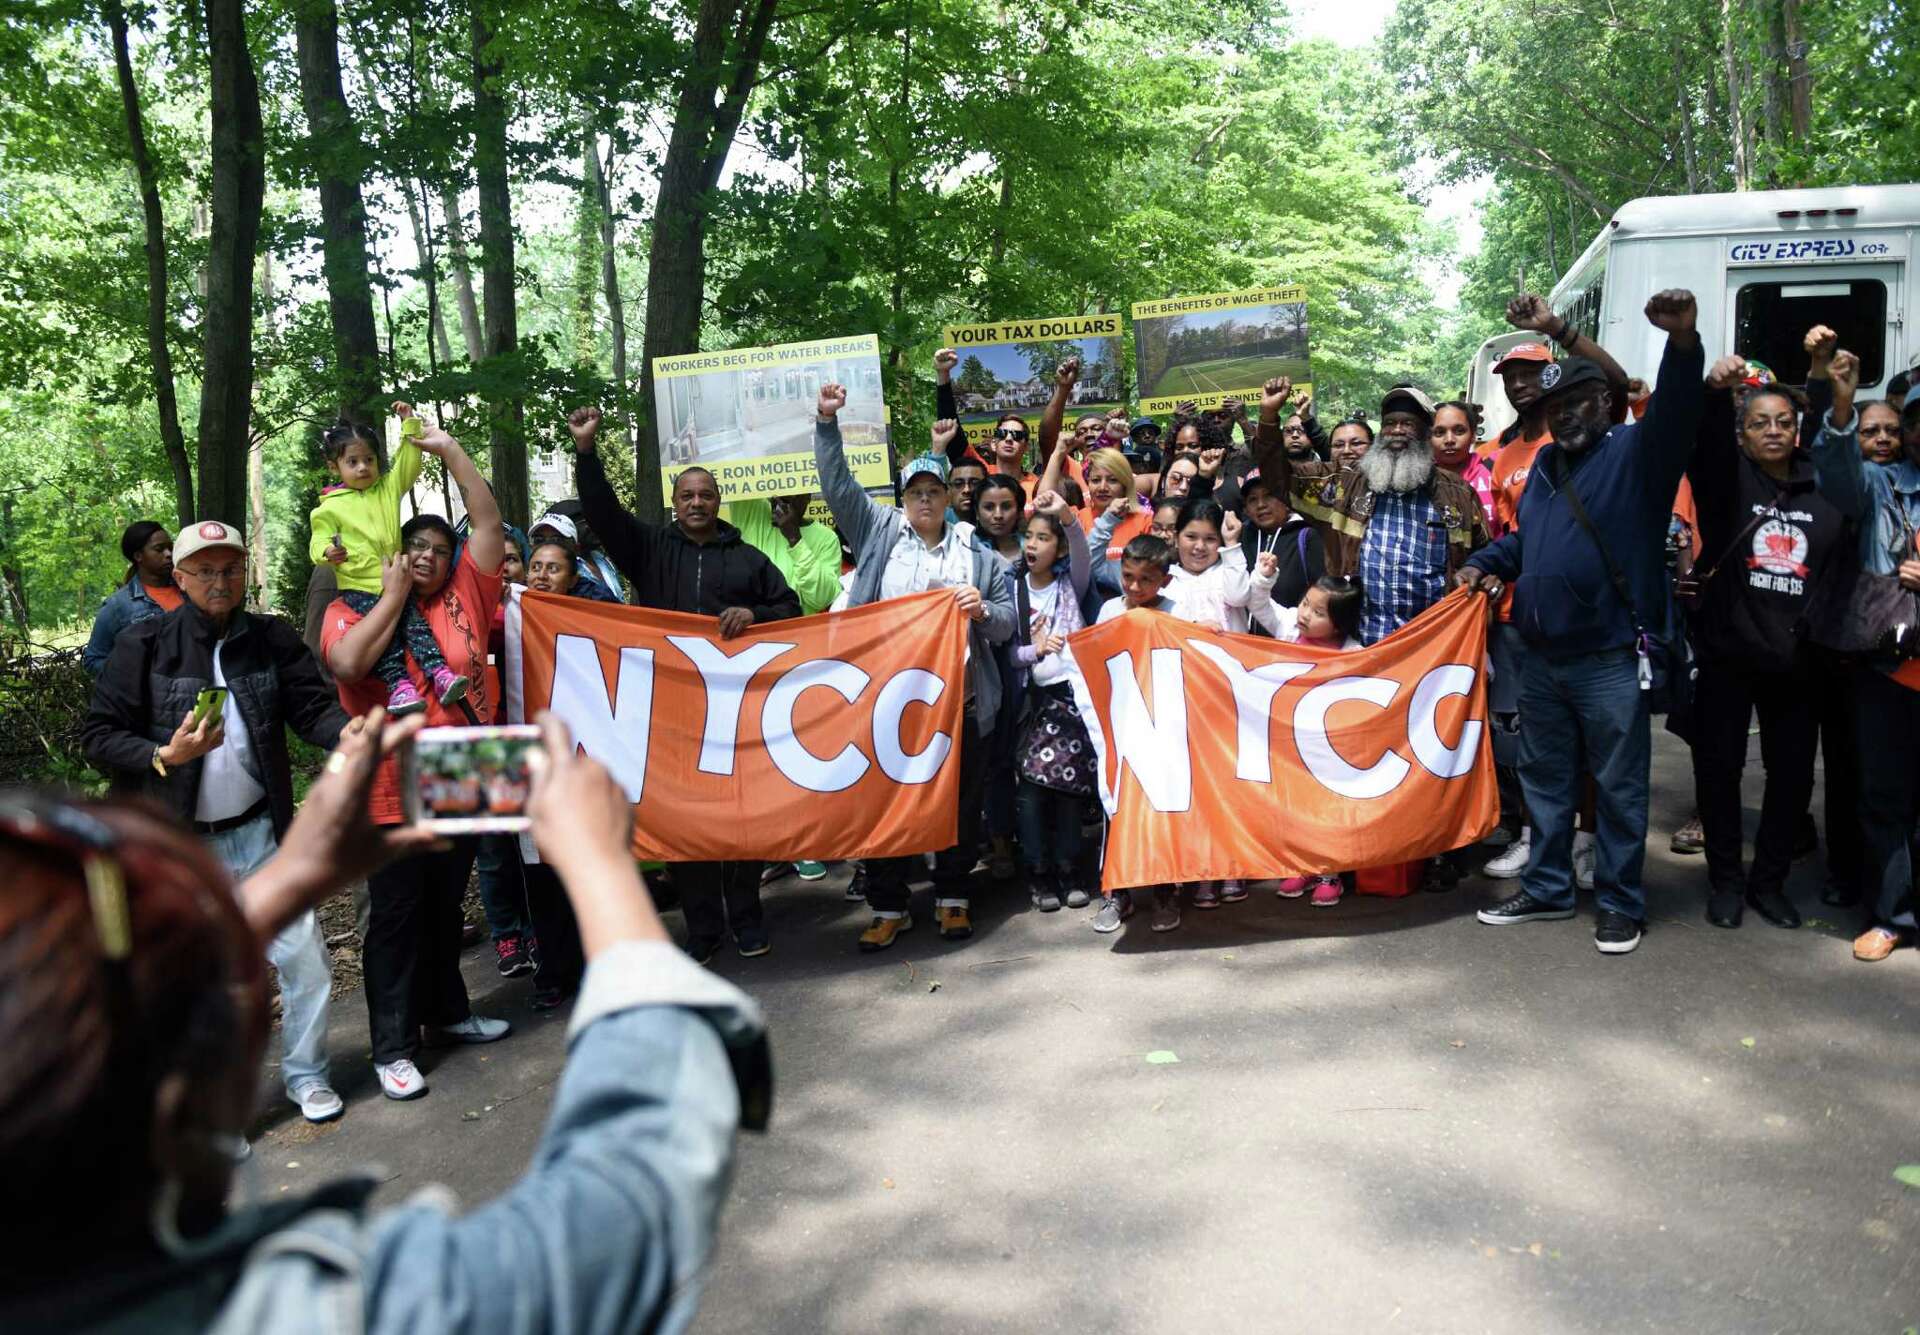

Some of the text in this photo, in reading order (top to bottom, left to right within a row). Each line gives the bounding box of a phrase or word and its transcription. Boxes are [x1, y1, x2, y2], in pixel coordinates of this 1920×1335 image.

[1776, 239, 1855, 259] EXPRESS
[1136, 288, 1301, 315] THE BENEFITS OF WAGE THEFT
[950, 318, 1116, 345] YOUR TAX DOLLARS
[658, 340, 873, 373] WORKERS BEG FOR WATER BREAKS
[1150, 399, 1173, 411] RON
[723, 465, 755, 480] RON
[760, 458, 817, 475] MOELIS
[741, 481, 752, 494] A
[755, 476, 797, 492] GOLD
[809, 505, 831, 516] EXP
[1749, 571, 1772, 590] FIGHT
[1772, 575, 1789, 592] FOR
[549, 633, 952, 804] NYCC
[1104, 638, 1484, 813] NYCC
